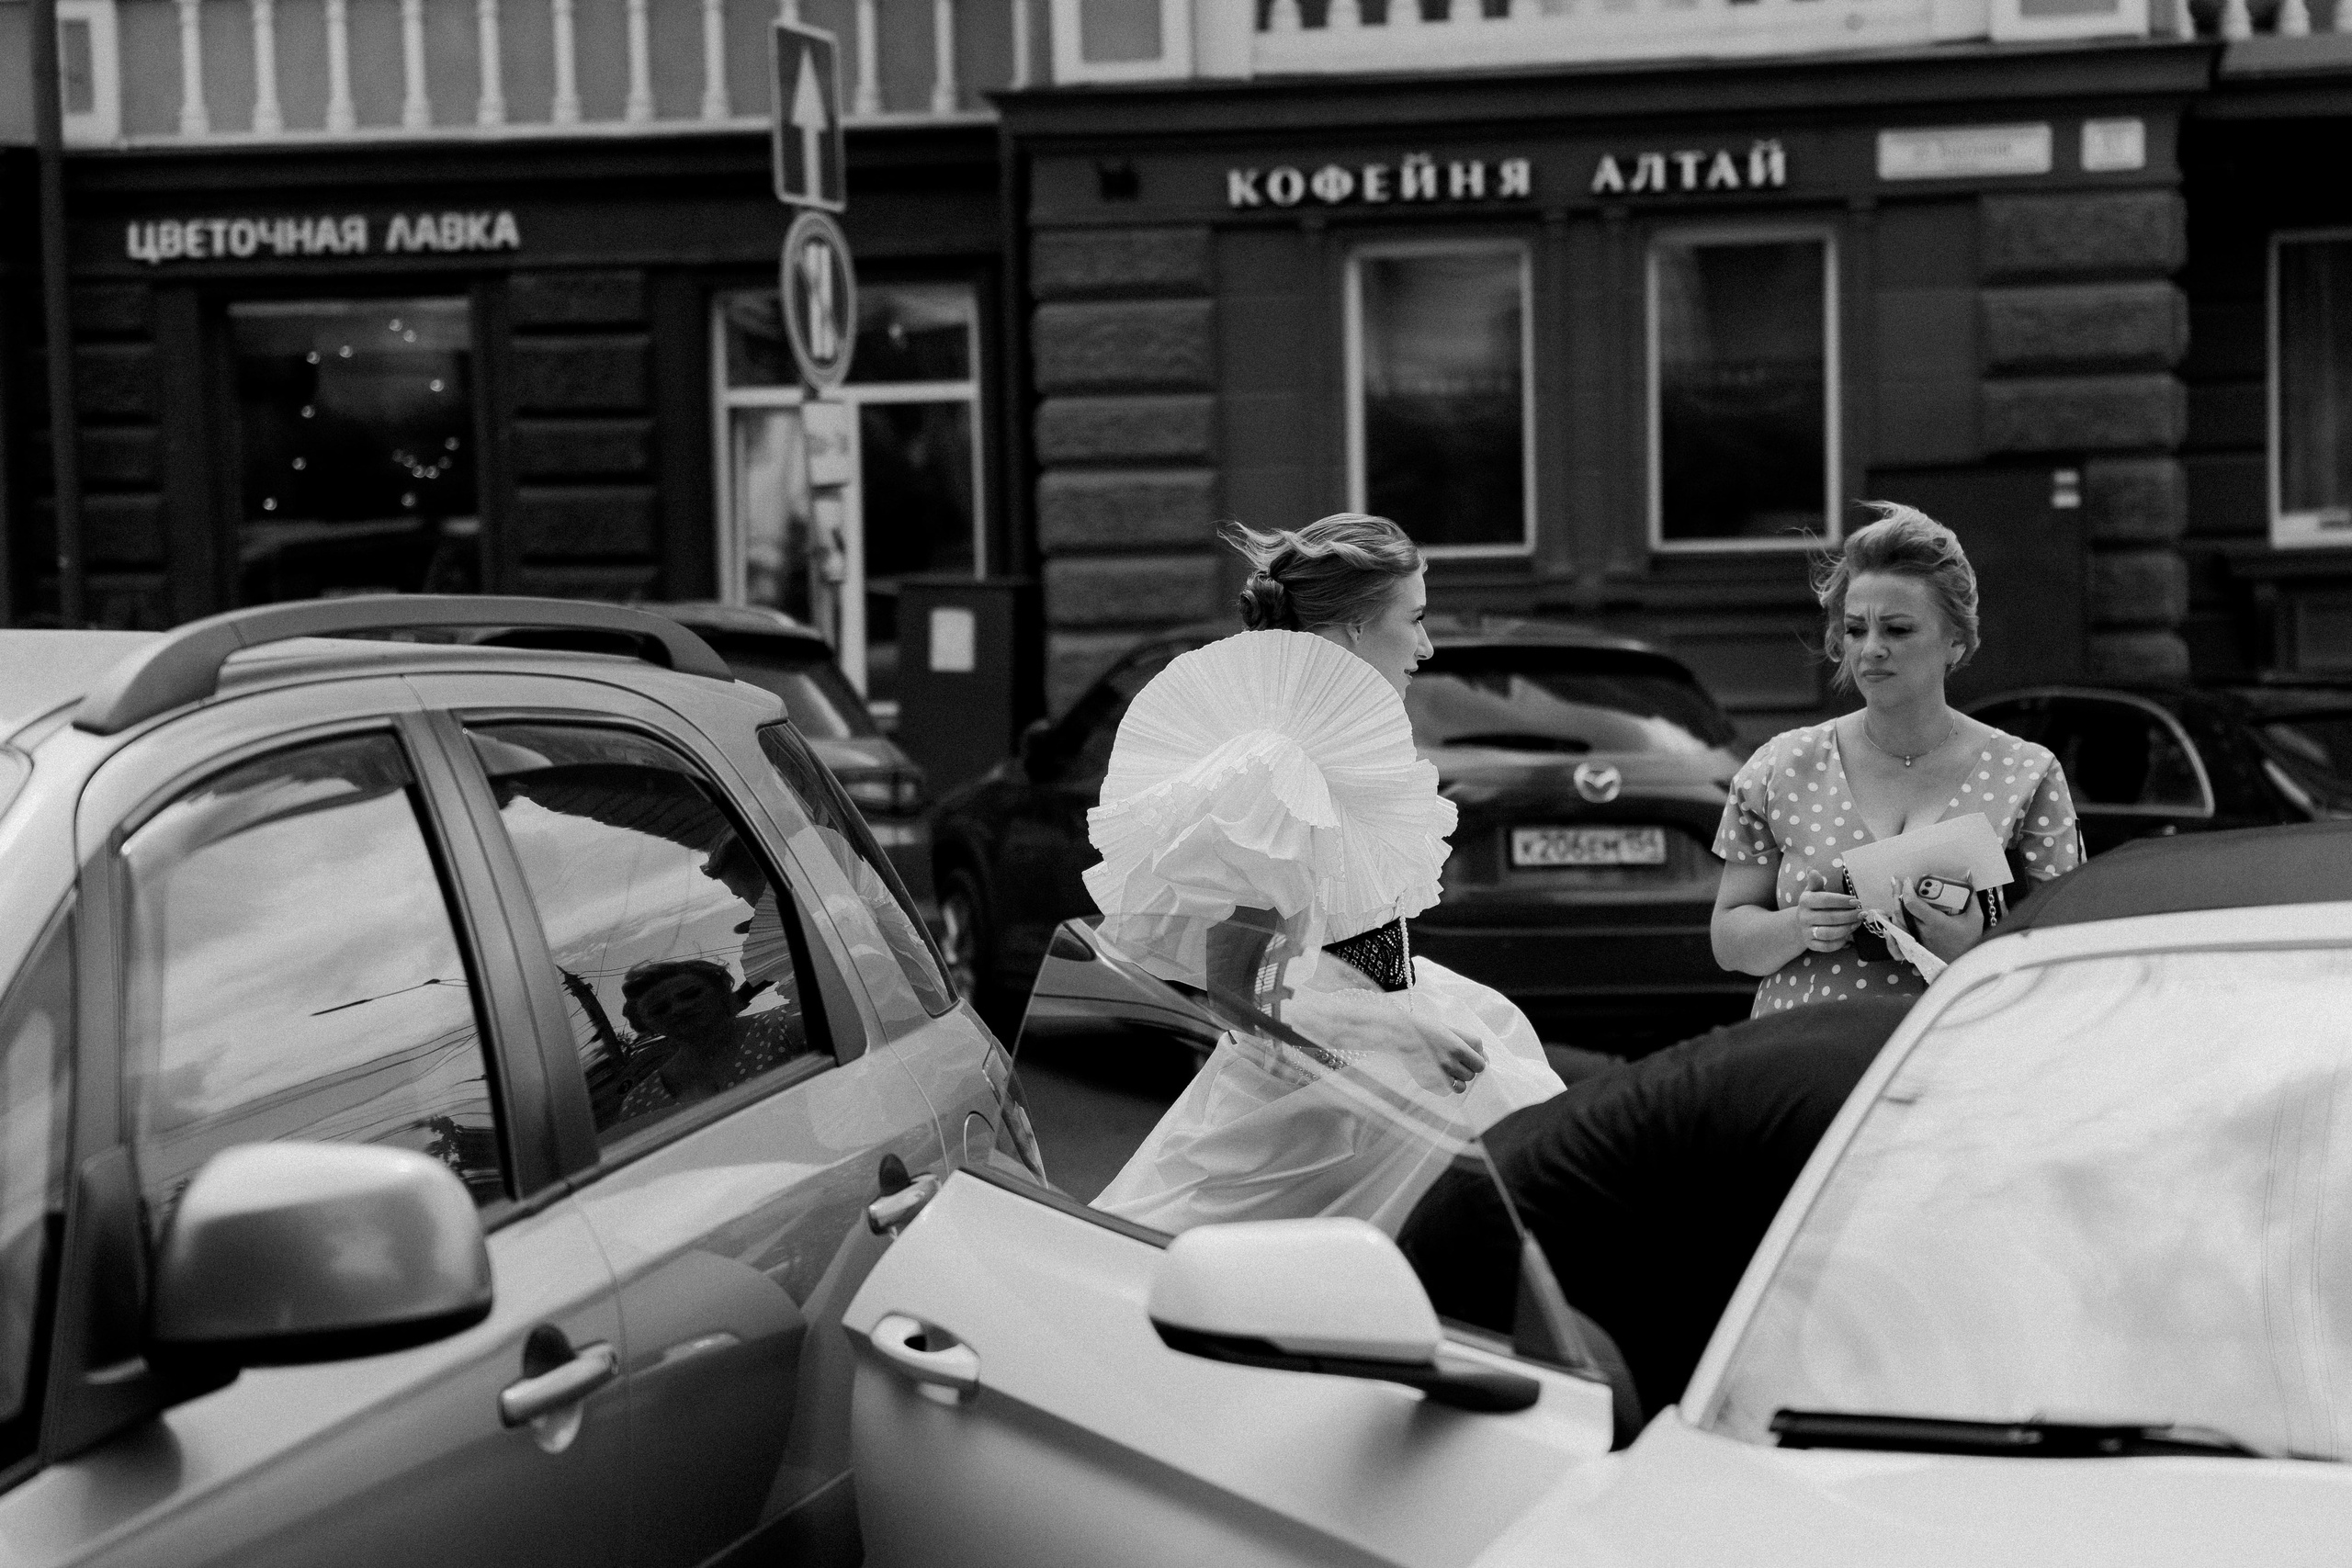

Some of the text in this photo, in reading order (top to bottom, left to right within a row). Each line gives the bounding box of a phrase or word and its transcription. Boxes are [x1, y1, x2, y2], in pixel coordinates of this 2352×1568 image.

[1227, 138, 1786, 208] КОФЕЙНЯ АЛТАЙ
[126, 210, 521, 265] ЦВЕТОЧНАЯ ЛАВКА
